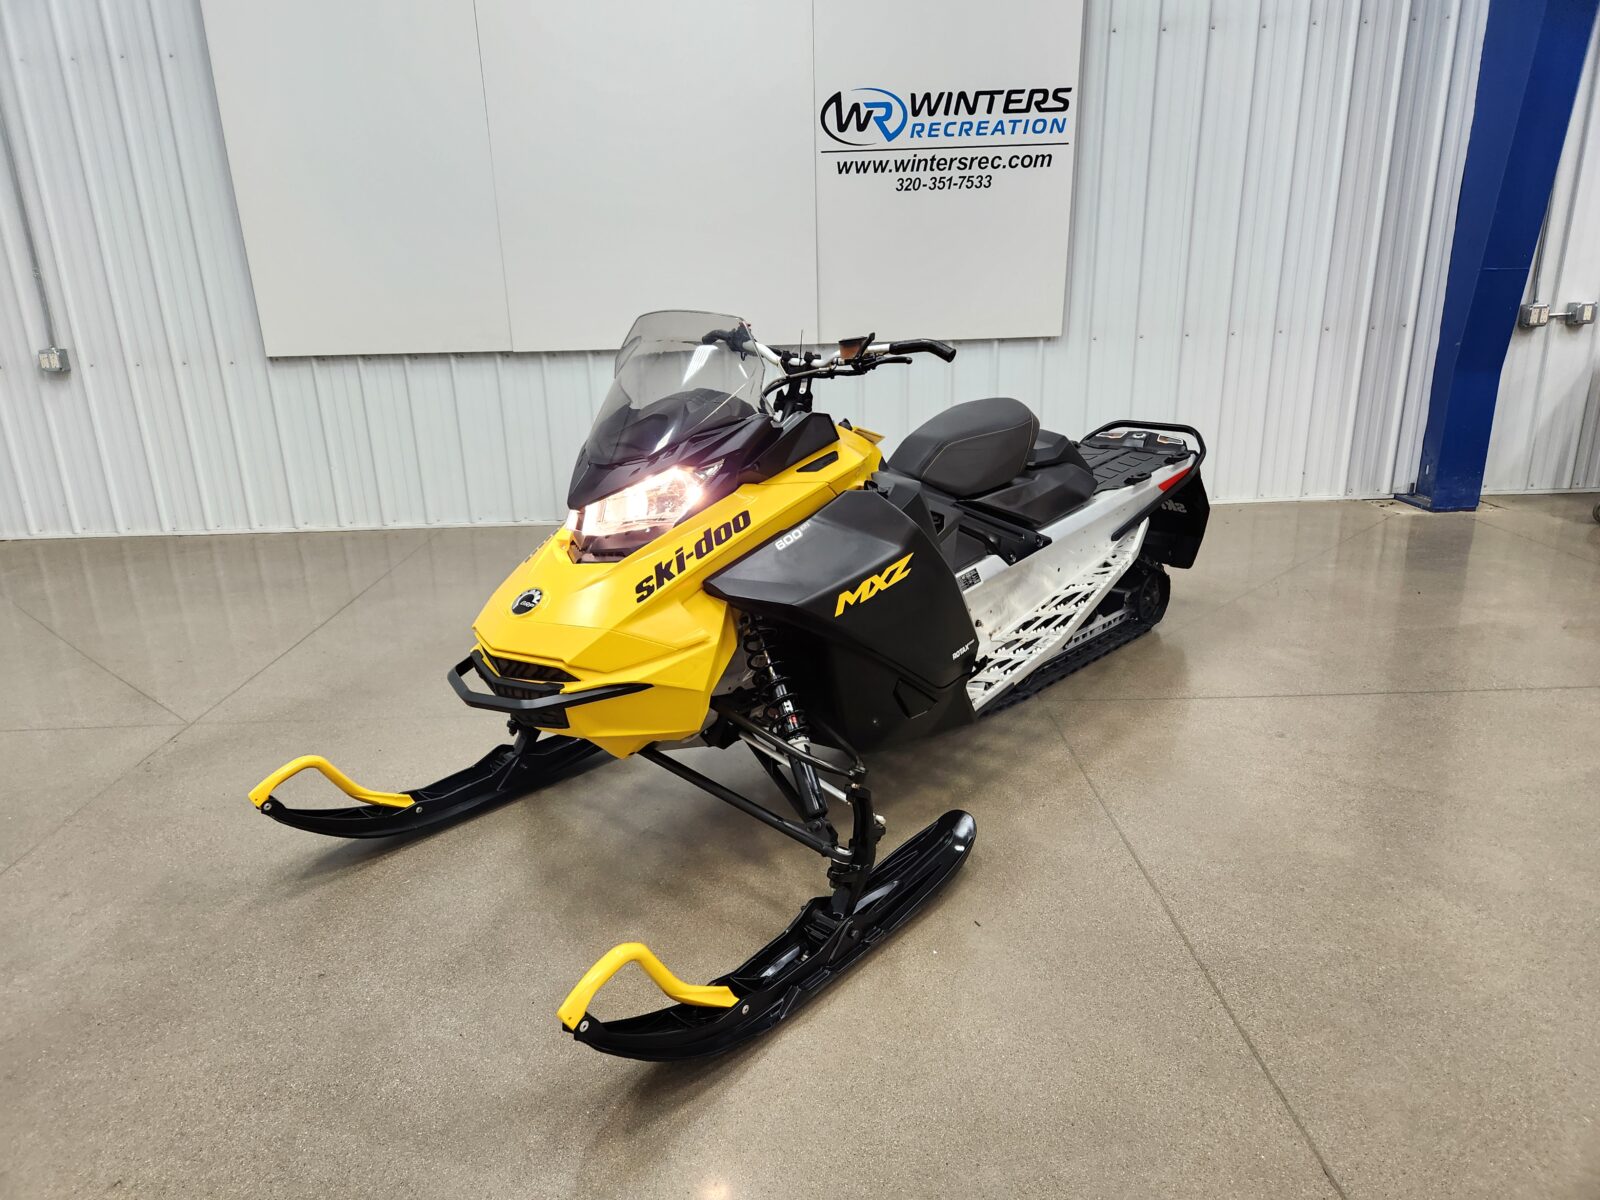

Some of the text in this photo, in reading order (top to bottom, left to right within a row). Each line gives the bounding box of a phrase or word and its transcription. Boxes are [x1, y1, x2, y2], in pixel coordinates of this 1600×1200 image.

[910, 87, 1072, 117] WINTERS
[910, 117, 1067, 138] RECREATION
[837, 153, 1053, 175] www.wintersrec.com
[895, 175, 992, 192] 320-351-7533
[775, 529, 803, 550] 600
[635, 510, 751, 604] ski-doo
[834, 552, 915, 618] MXZ
